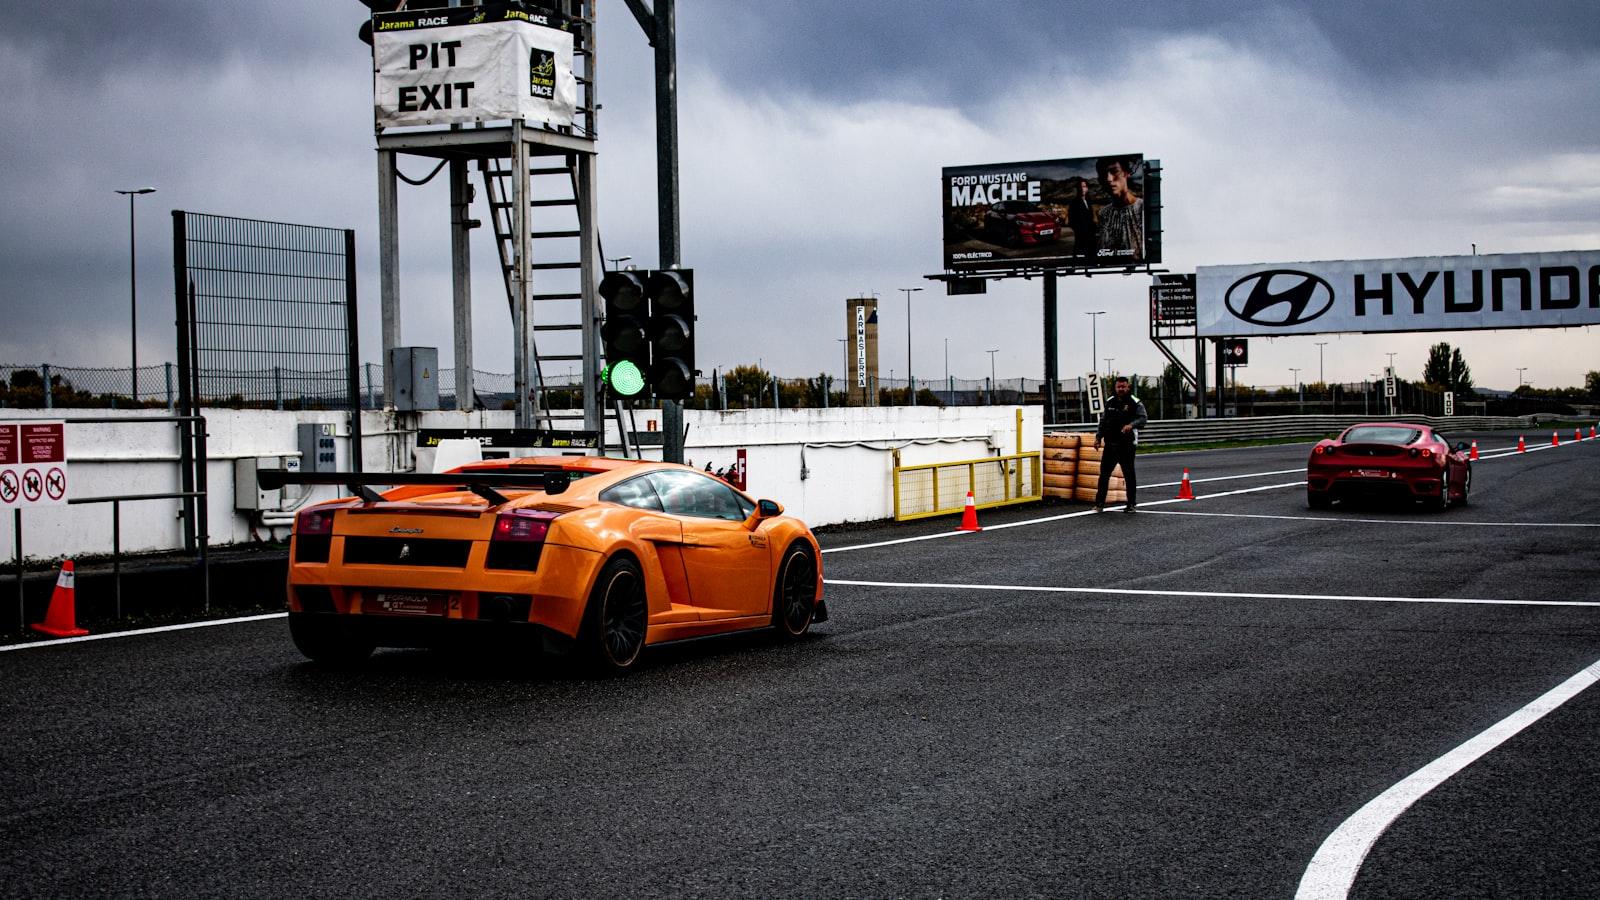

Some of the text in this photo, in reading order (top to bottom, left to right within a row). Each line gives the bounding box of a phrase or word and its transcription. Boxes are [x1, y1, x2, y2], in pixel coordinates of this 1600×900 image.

[379, 17, 448, 30] Jarama RACE
[504, 9, 548, 25] Jarama RACE
[409, 40, 462, 70] PIT
[531, 75, 554, 86] Jarama
[398, 81, 475, 112] EXIT
[532, 85, 553, 97] RACE
[951, 172, 1027, 186] FORD MUSTANG
[951, 181, 1041, 207] MACH-E
[1354, 265, 1600, 316] HYUND
[1386, 367, 1394, 396] 150
[1088, 374, 1100, 411] 200
[552, 438, 586, 447] Jarama RACE
[450, 600, 460, 611] 2
